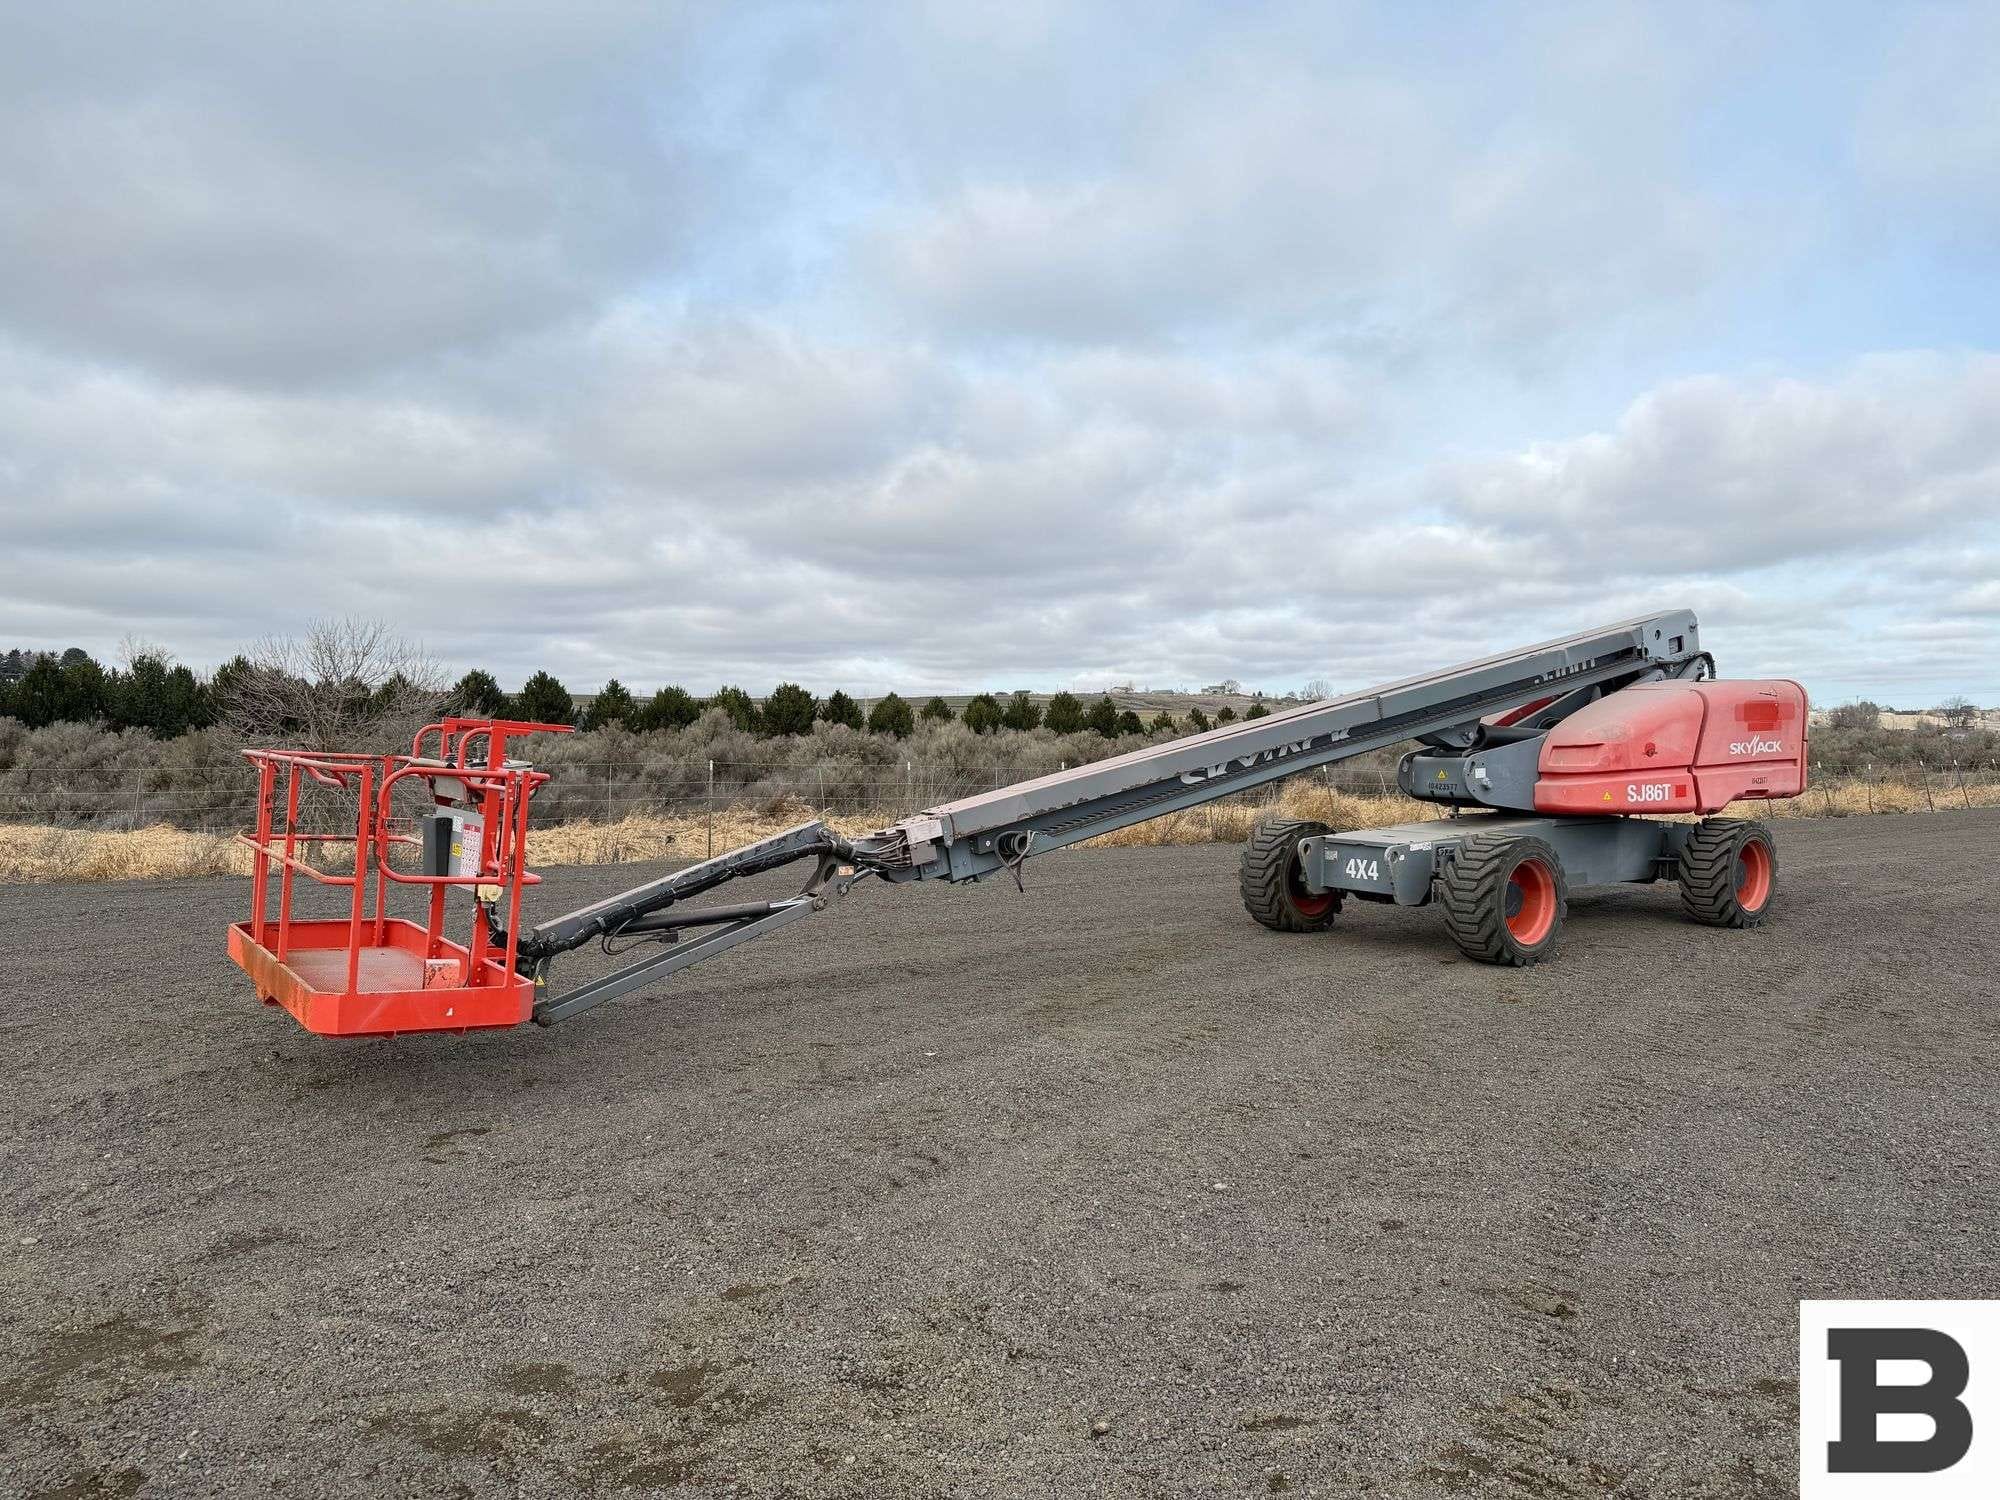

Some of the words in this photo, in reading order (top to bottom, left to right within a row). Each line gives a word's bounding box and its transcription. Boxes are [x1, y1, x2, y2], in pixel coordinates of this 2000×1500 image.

[1729, 734, 1782, 756] SKYJACK
[1627, 783, 1671, 802] SJ86T
[1345, 858, 1379, 880] 4X4
